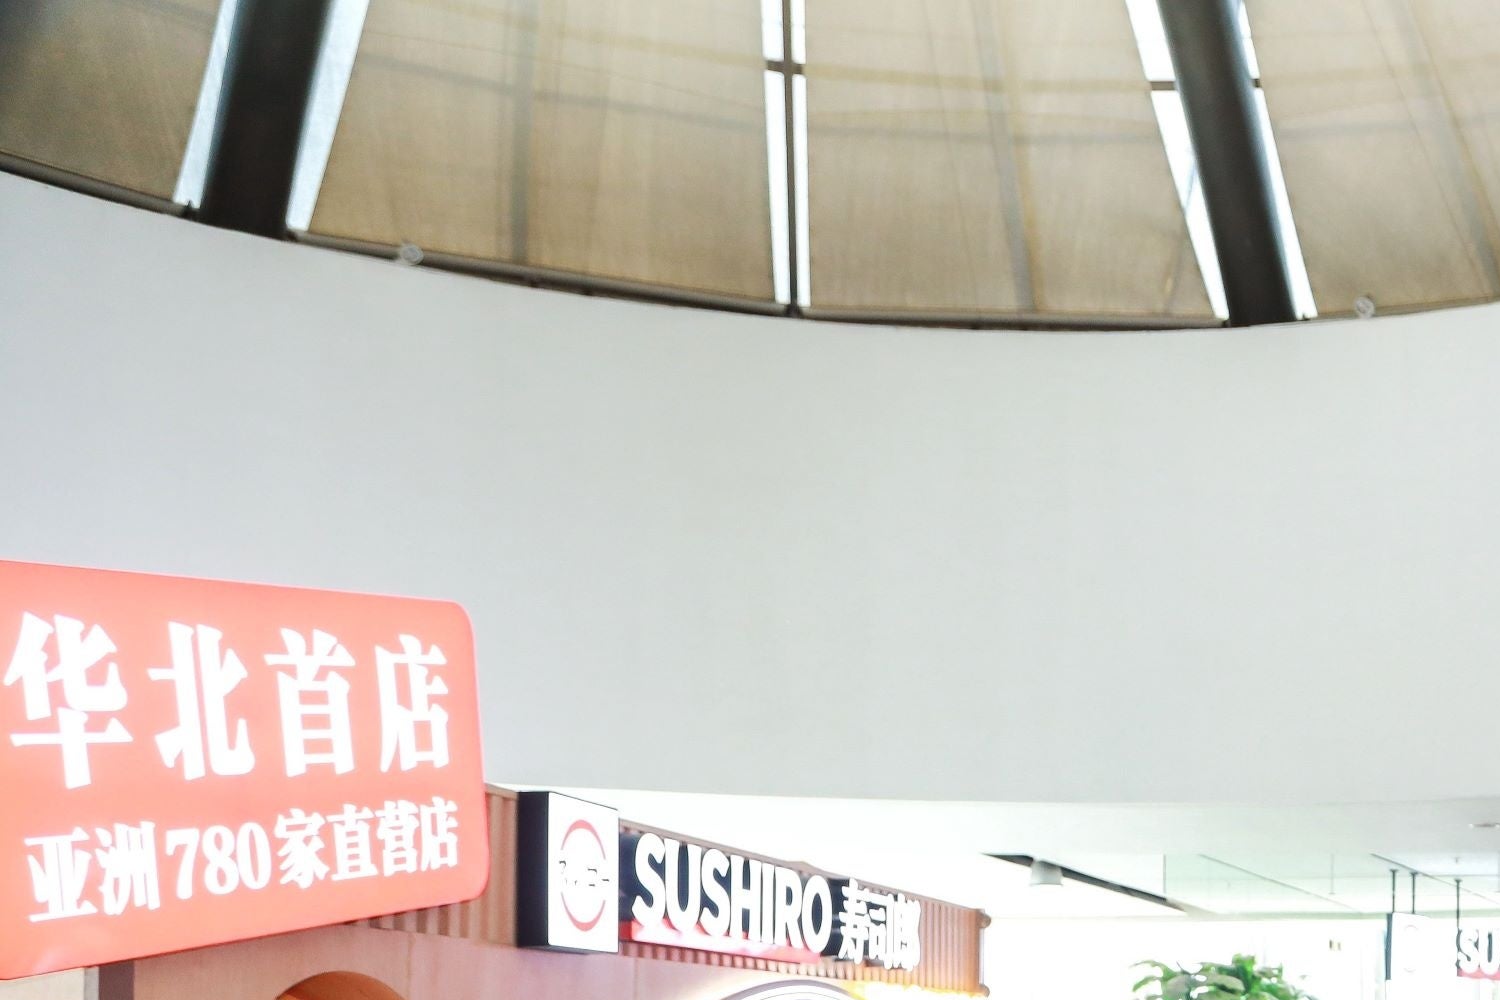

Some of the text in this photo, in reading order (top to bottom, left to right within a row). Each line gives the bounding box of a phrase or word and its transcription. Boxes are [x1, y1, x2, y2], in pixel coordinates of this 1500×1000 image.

[3, 611, 450, 789] 华北首店
[24, 796, 458, 923] 亚洲780家直营店
[632, 833, 832, 953] SUSHIRO
